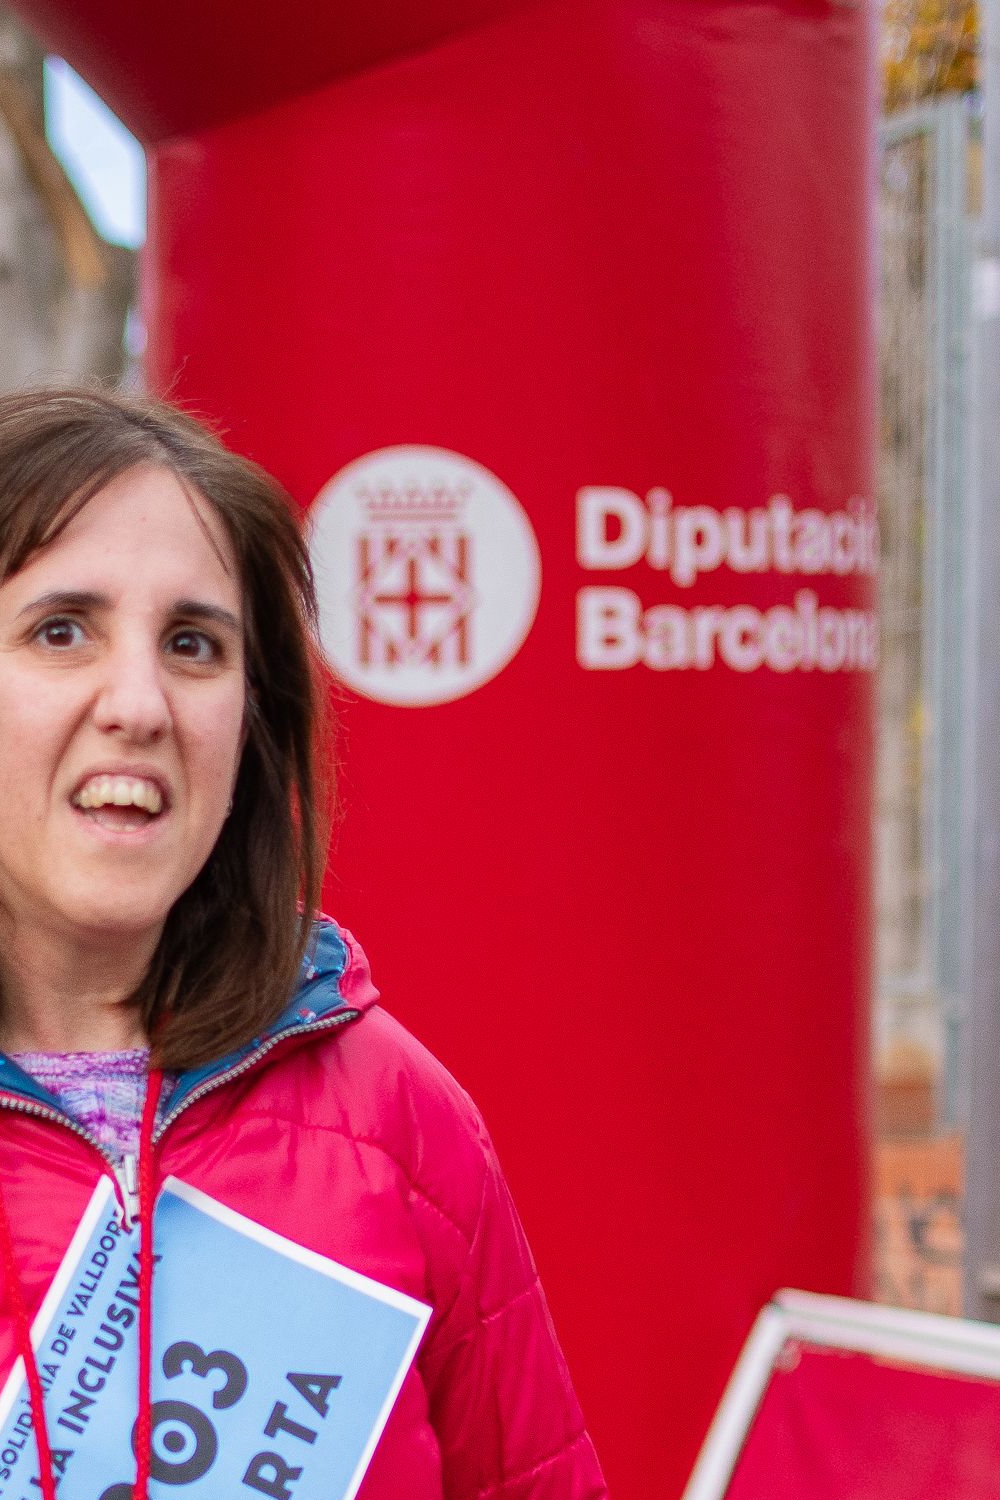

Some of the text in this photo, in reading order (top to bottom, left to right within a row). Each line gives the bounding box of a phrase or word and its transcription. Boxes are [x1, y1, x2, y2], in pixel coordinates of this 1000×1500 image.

[575, 485, 877, 588] Diputaci
[575, 585, 876, 672] Barcelon
[50, 1323, 77, 1356] DE
[66, 1208, 124, 1317] VALLDOR
